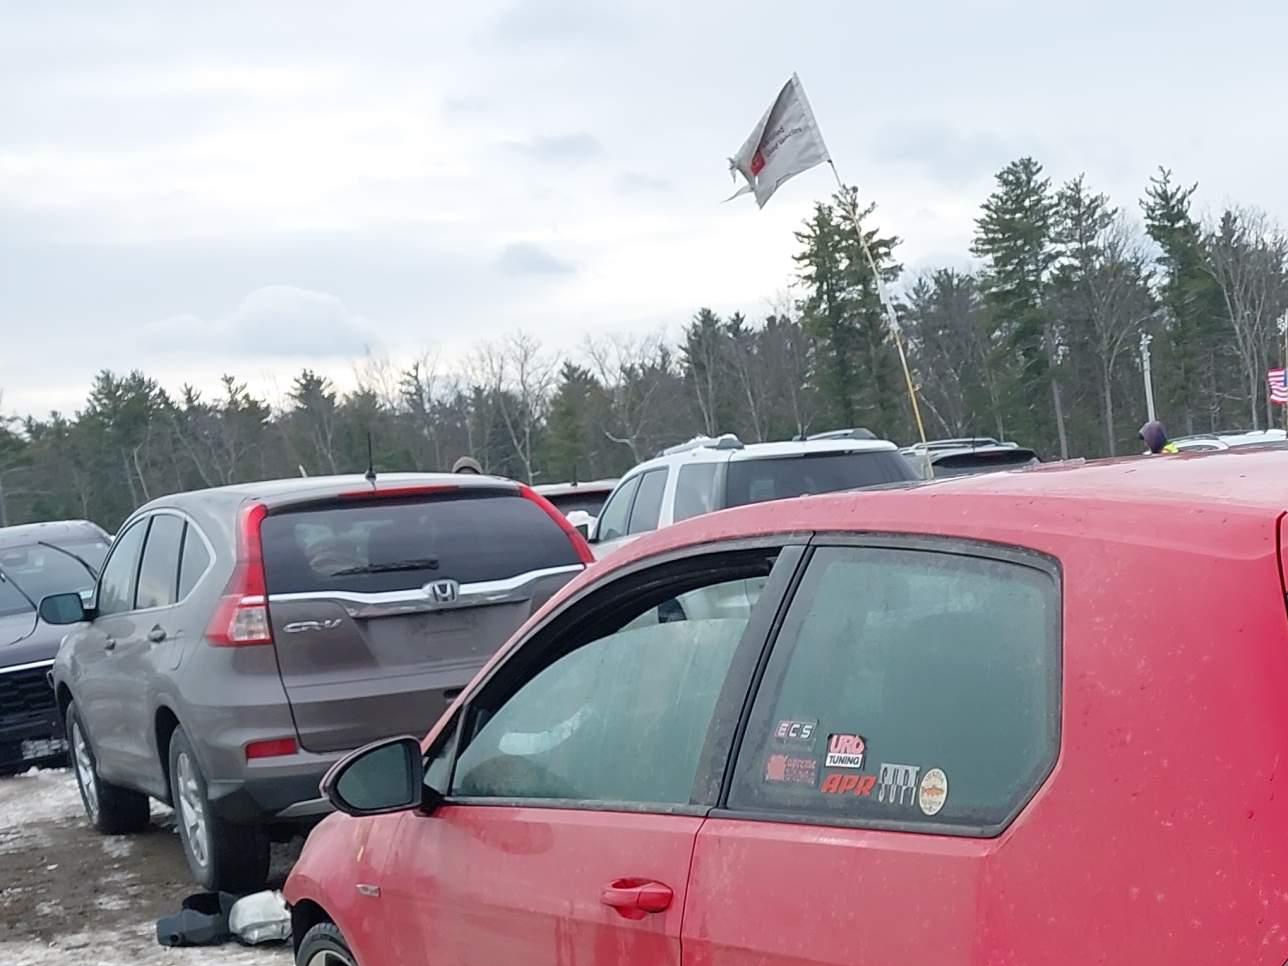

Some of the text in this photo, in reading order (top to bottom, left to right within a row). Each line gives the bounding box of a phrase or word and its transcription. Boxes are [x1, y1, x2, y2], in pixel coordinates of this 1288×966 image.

[777, 722, 813, 739] ECS
[828, 755, 860, 766] TUNING
[820, 773, 877, 796] APR
